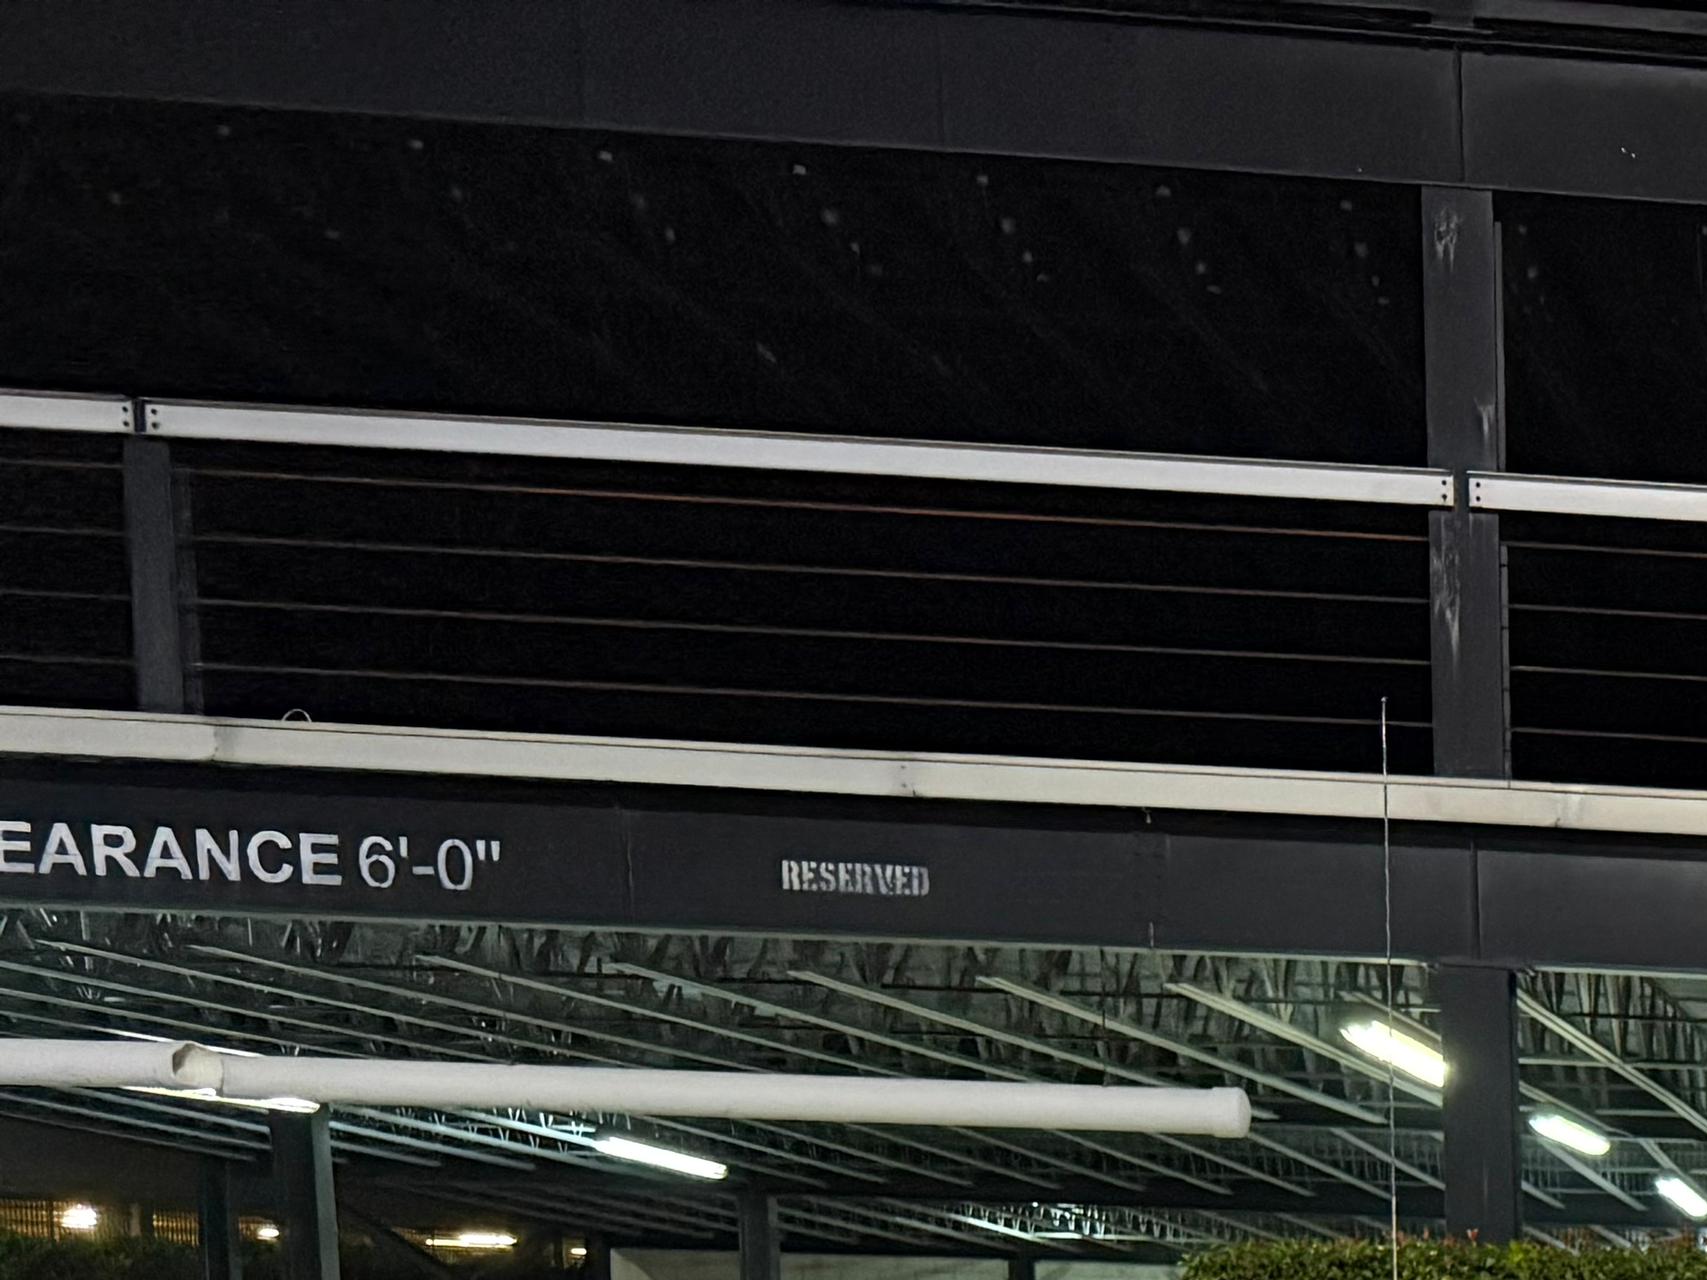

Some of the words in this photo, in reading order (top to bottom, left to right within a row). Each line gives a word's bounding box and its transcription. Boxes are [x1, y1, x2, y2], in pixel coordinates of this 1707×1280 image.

[0, 821, 343, 887] EARANCE
[358, 835, 500, 891] 6'-0"
[781, 859, 930, 896] RESERVED
